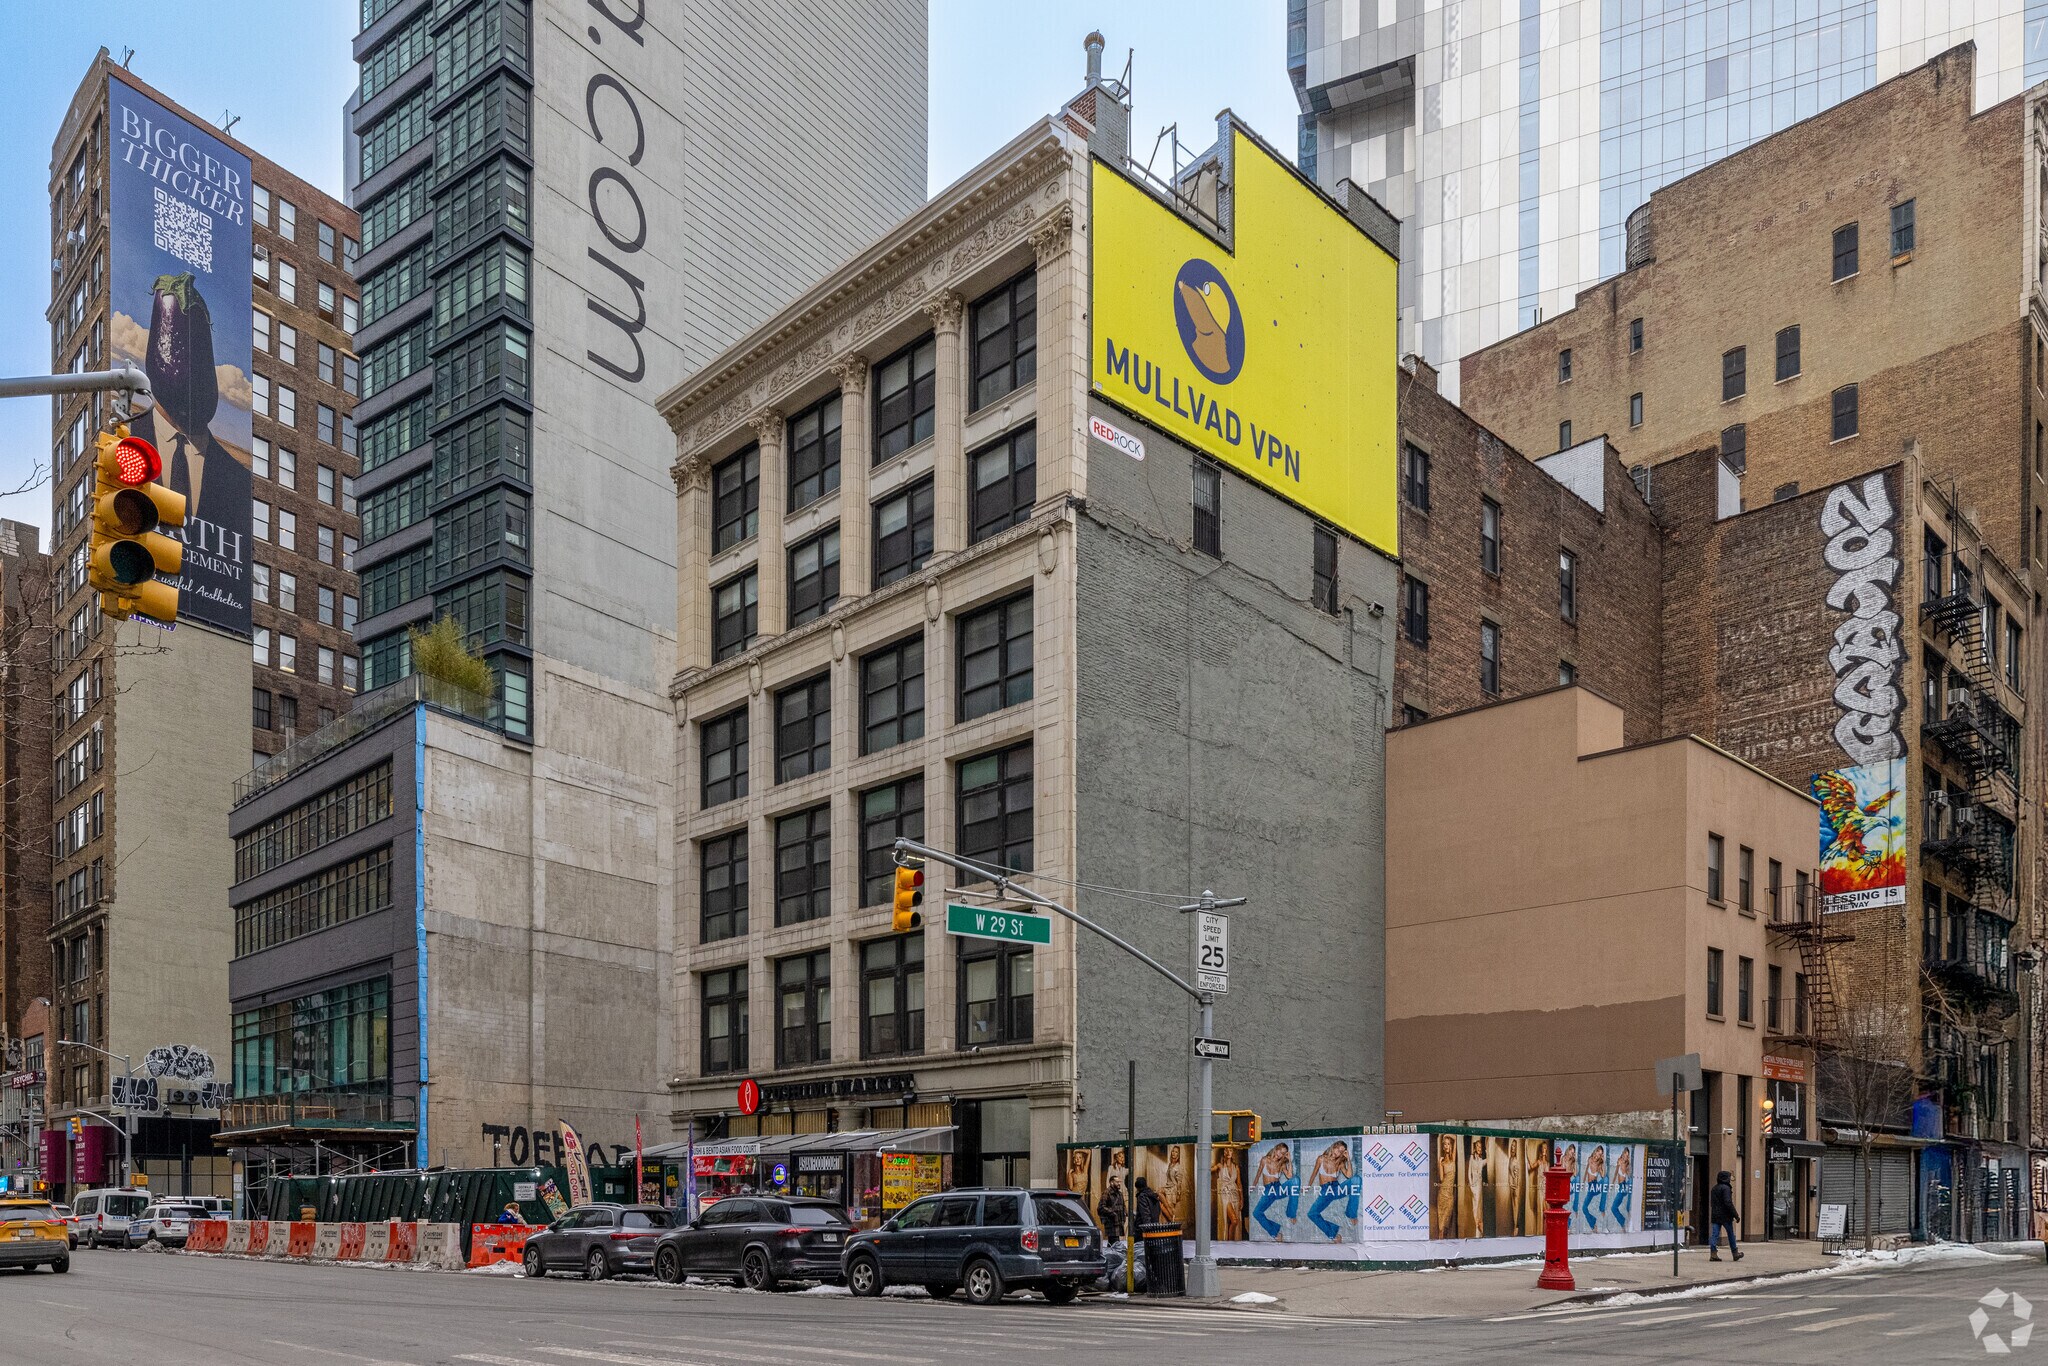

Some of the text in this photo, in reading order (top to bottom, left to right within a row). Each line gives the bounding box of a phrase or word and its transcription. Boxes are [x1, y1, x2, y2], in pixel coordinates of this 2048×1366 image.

[120, 104, 244, 200] BIGGER
[120, 137, 244, 226] THICKER
[1106, 337, 1300, 482] MULLVAD VPN
[152, 515, 243, 564] RTH
[181, 547, 243, 581] CEMENT
[195, 585, 243, 610] Aesthetics
[1885, 888, 1898, 898] IS
[1851, 900, 1870, 909] WAY
[975, 913, 1024, 937] W 29 St
[1205, 916, 1219, 925] CITY
[1203, 924, 1222, 935] SPEED
[1204, 934, 1220, 944] LIMIT
[1201, 944, 1224, 968] 25
[1204, 975, 1221, 983] PHOTO
[1200, 981, 1225, 991] ENFORCED
[1200, 1043, 1227, 1054] ONE WAY
[13, 1072, 34, 1086] PSYCHIC
[835, 1073, 914, 1096] MARKET
[1782, 1118, 1792, 1126] NYC
[1773, 1126, 1801, 1135] BARBERSHOP
[720, 1145, 731, 1154] ASIAN
[731, 1145, 742, 1154] FOOD
[742, 1144, 757, 1154] COURT
[892, 1157, 910, 1165] OPEN
[1364, 1152, 1382, 1171] ENRON
[1398, 1152, 1417, 1171] ENRON
[1248, 1185, 1300, 1197] FRAME
[1301, 1184, 1361, 1197] FRAME
[1580, 1183, 1608, 1193] FRAME
[1608, 1183, 1632, 1193] FRAME
[1364, 1205, 1382, 1224] ENRON
[1399, 1205, 1417, 1224] ENRON
